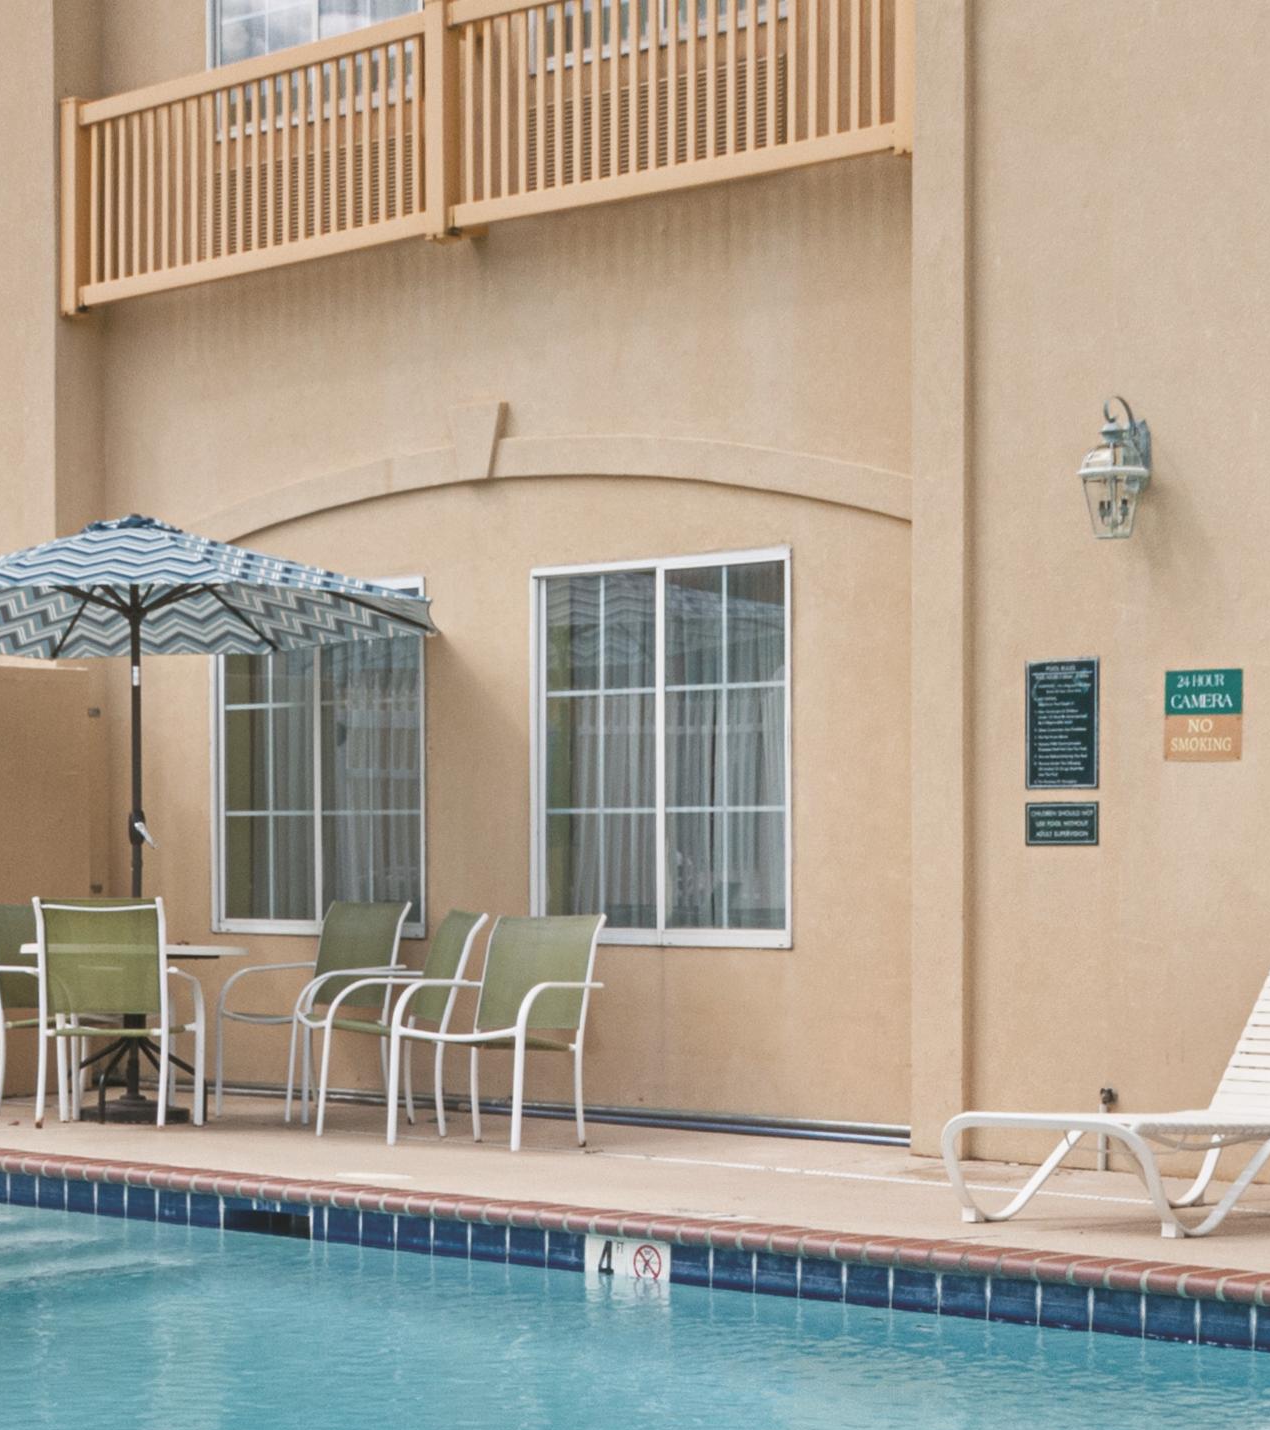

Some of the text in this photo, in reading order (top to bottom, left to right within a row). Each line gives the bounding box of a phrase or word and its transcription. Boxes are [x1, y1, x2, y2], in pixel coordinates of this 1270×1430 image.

[1177, 673, 1225, 688] 24 HOUR
[1170, 692, 1233, 709] CAMERA
[1187, 718, 1213, 733] NO
[1170, 736, 1232, 752] SMOKING
[598, 1240, 614, 1275] 4
